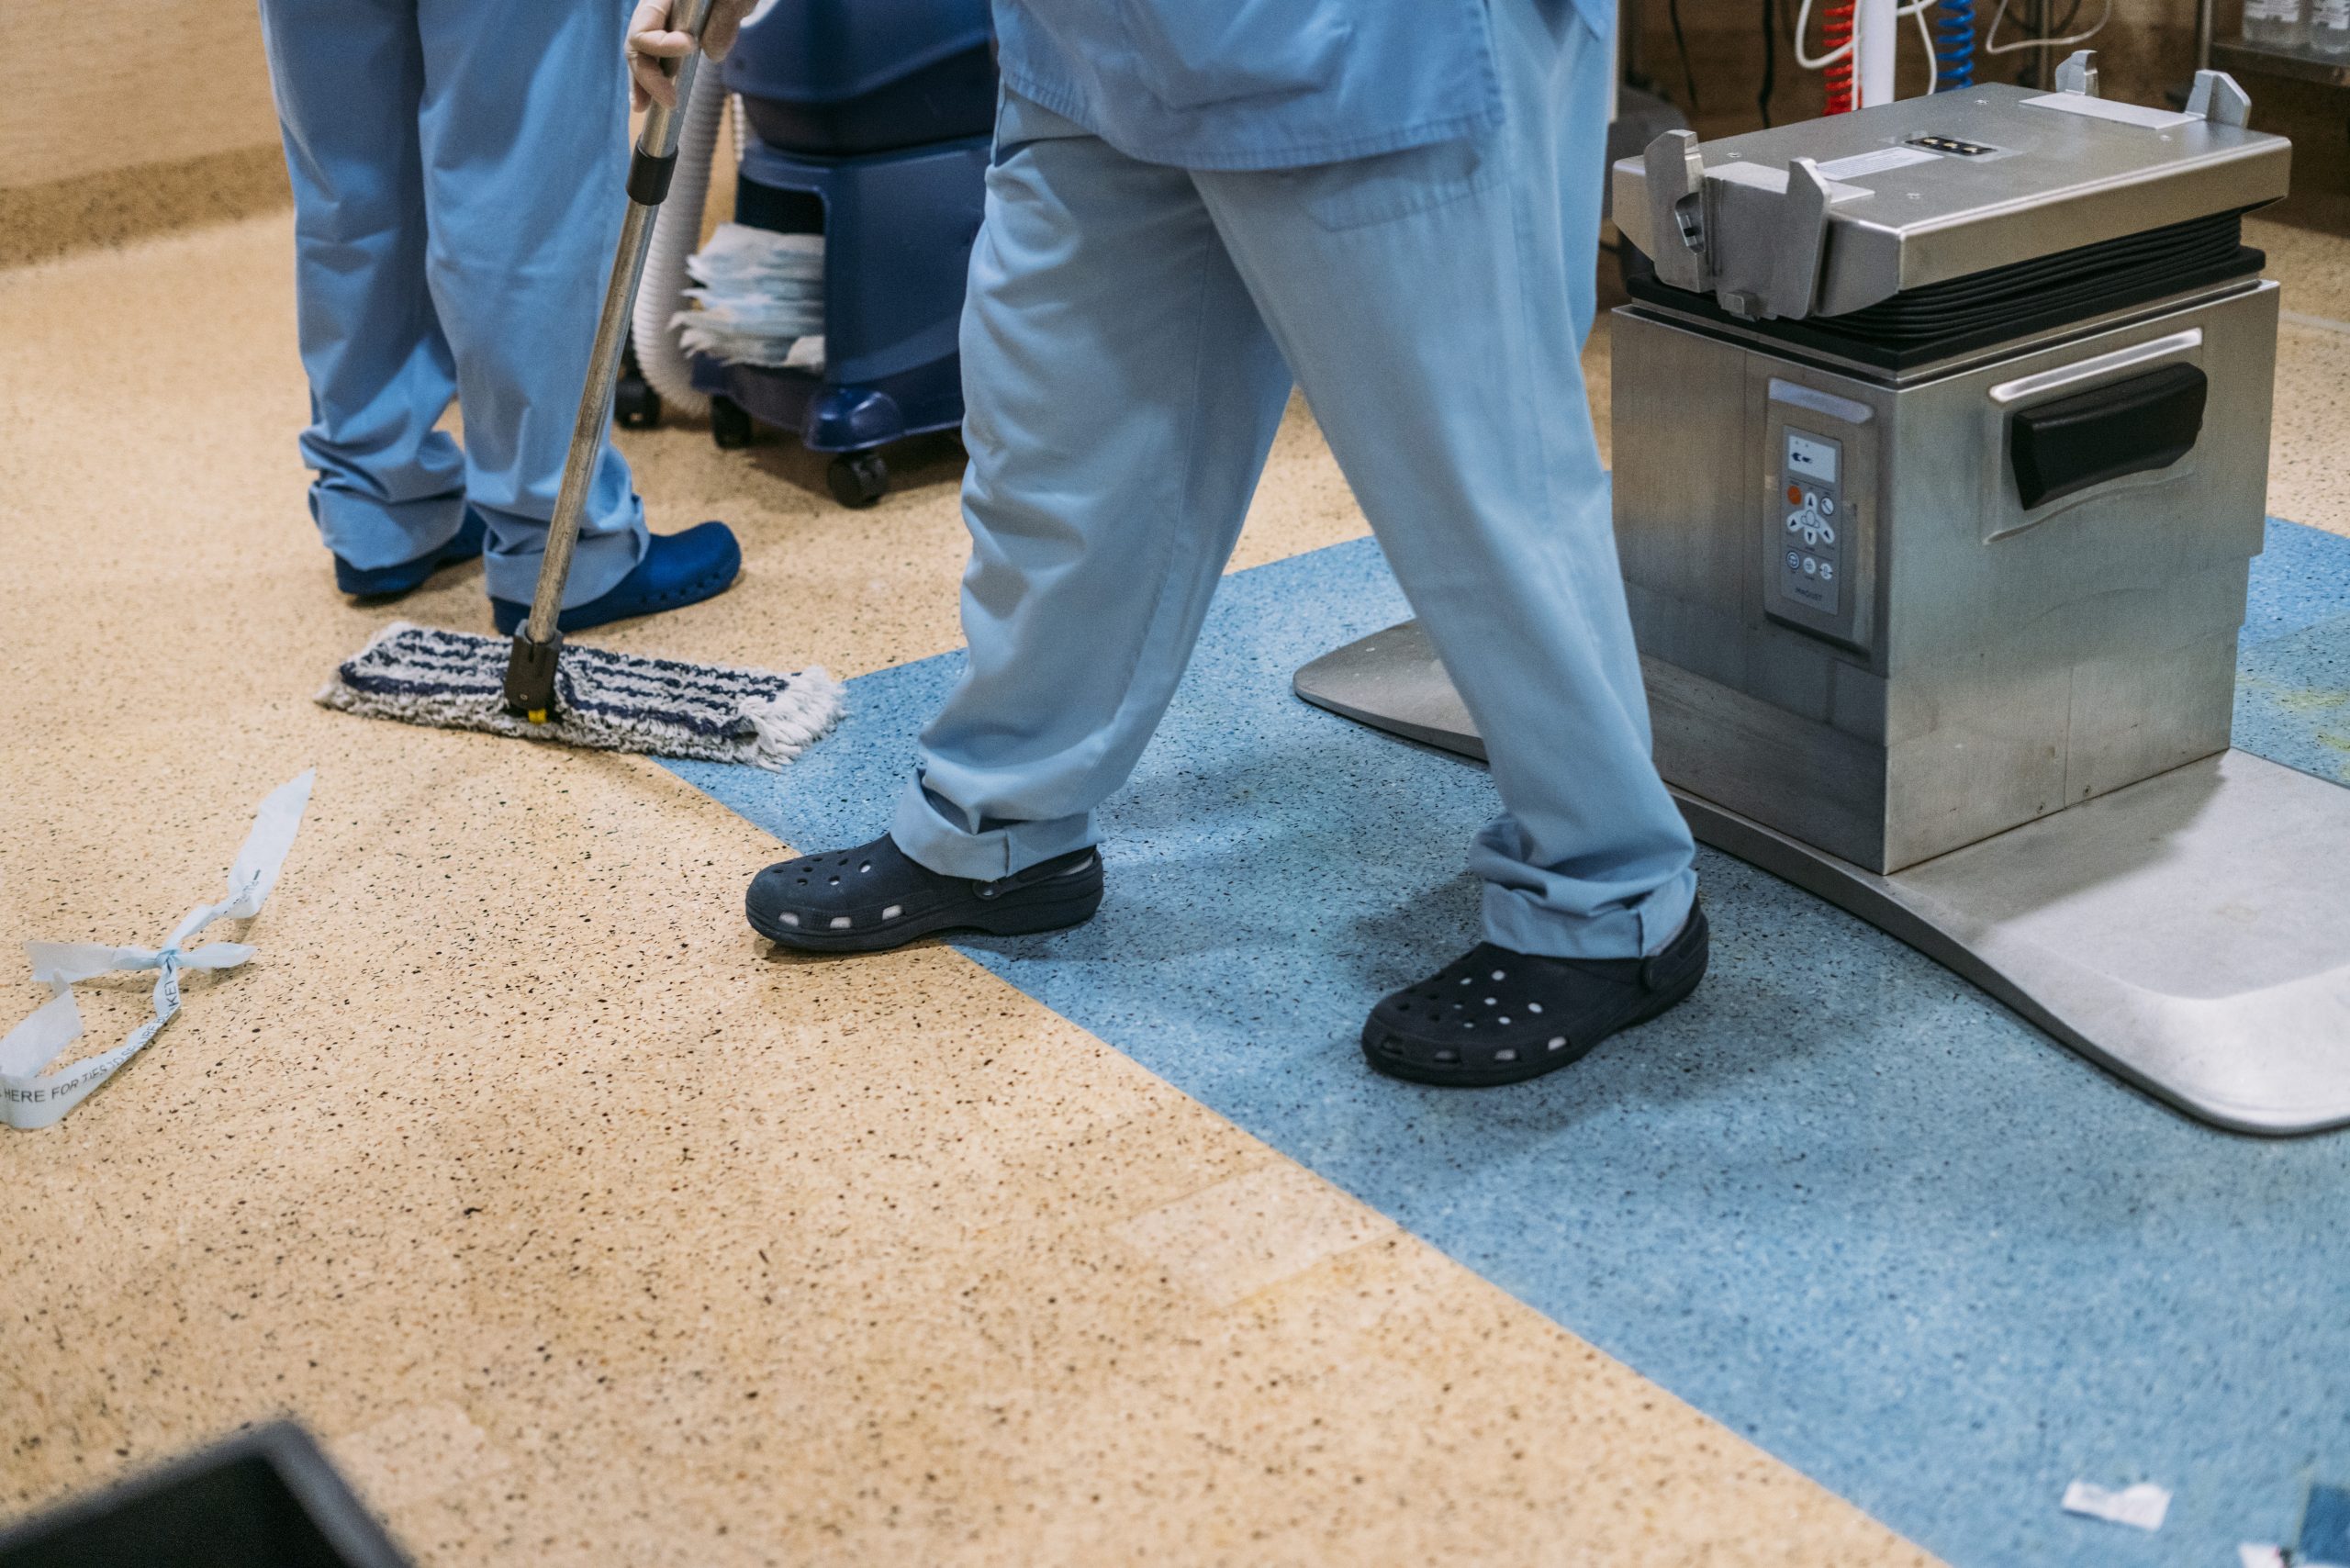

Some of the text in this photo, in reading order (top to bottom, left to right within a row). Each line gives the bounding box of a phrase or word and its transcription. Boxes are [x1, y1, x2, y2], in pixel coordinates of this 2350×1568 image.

[4, 1087, 46, 1103] HERE
[51, 1079, 79, 1100] FOR
[83, 1064, 108, 1083] TIES
[120, 1025, 156, 1058] SEURE
